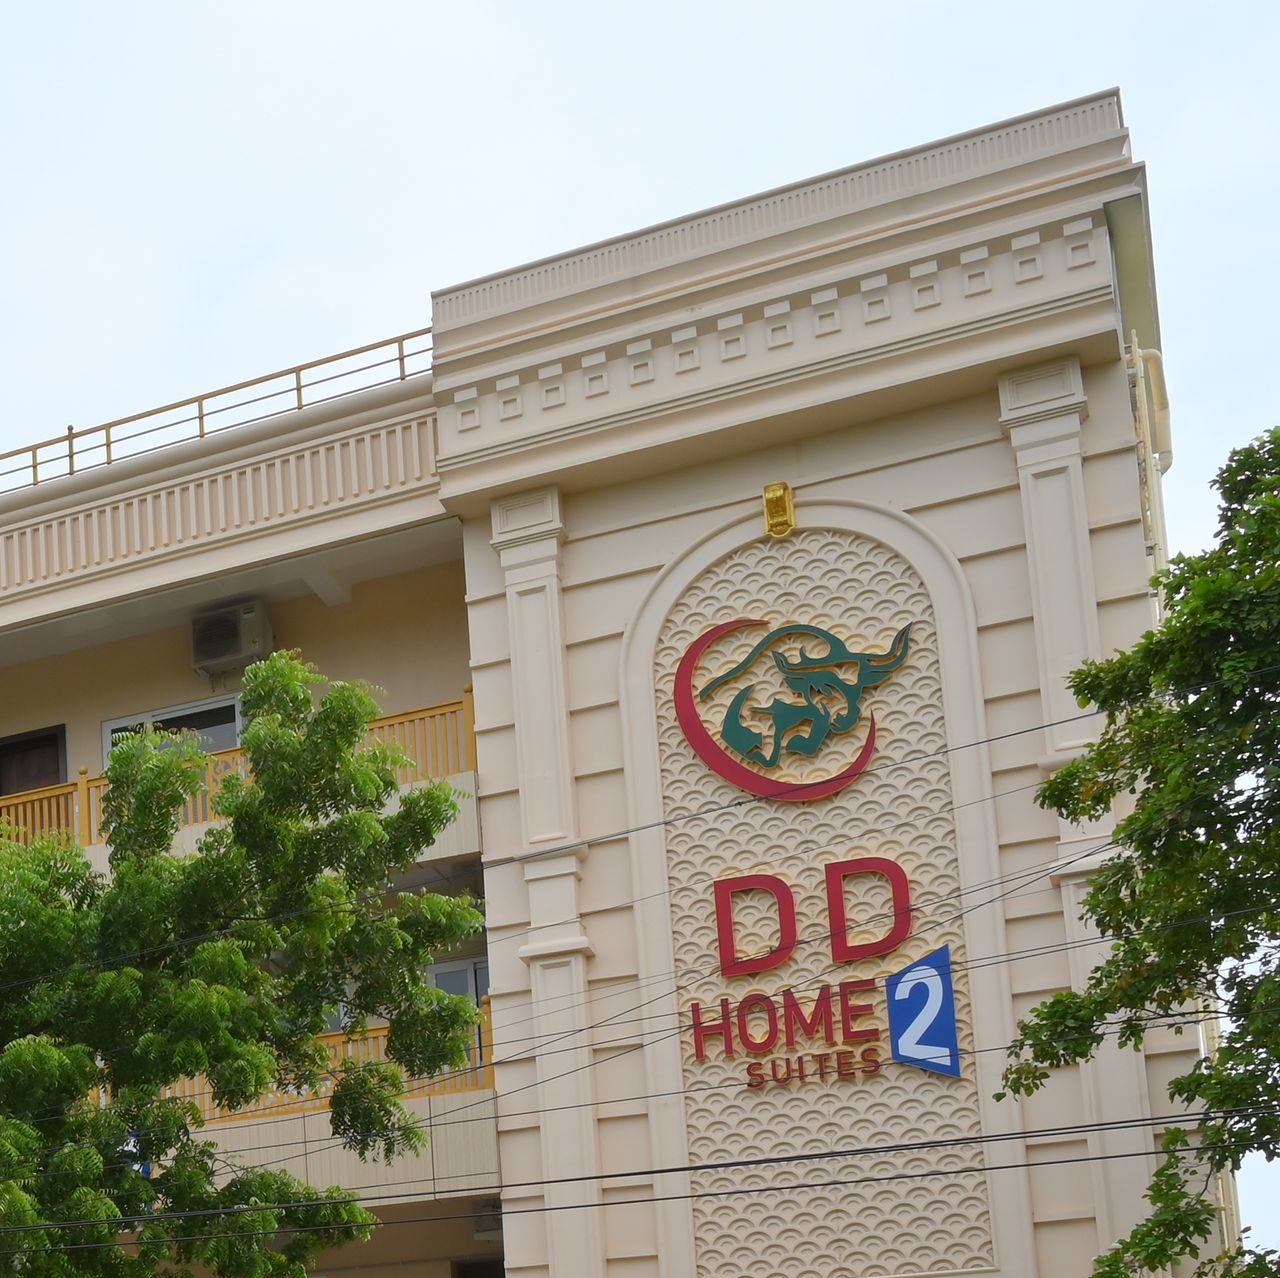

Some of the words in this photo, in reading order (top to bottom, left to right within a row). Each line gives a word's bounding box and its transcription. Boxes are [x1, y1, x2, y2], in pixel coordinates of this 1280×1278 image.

[690, 977, 881, 1062] HOME
[894, 965, 952, 1067] 2
[745, 1047, 882, 1089] SUITES
